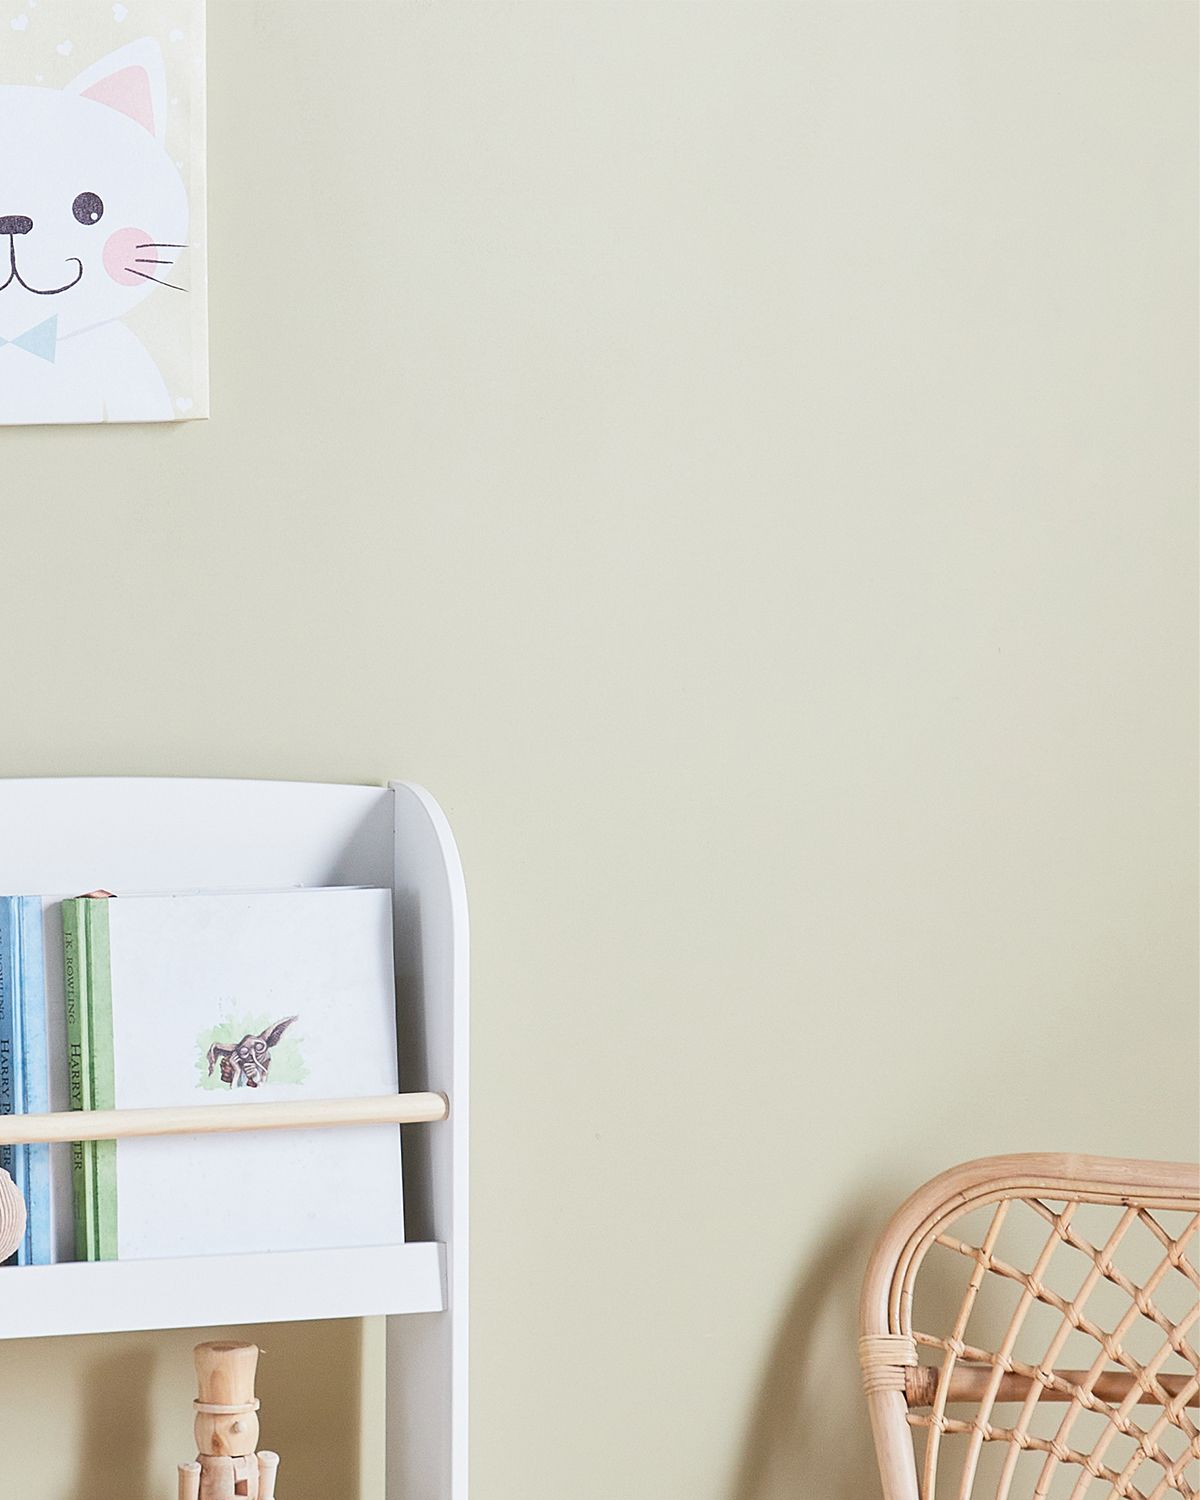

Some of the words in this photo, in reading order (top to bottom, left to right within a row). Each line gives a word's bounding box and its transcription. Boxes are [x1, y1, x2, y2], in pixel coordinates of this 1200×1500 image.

[66, 957, 76, 1024] ROWLING
[0, 1039, 10, 1098] HARRY
[70, 1043, 81, 1100] HARRY
